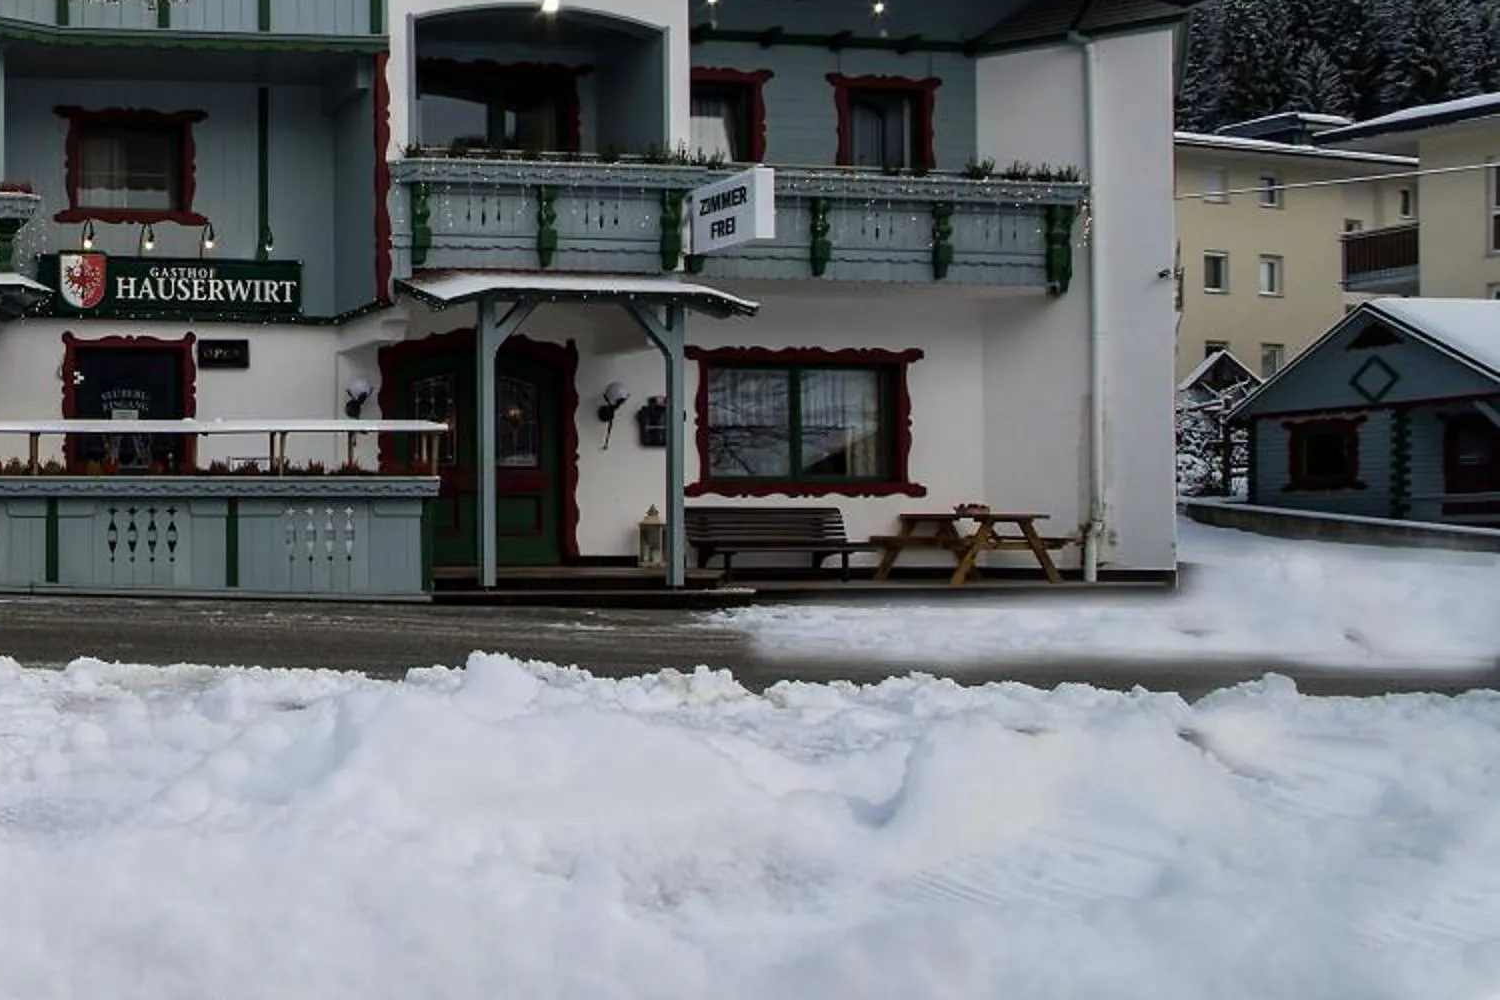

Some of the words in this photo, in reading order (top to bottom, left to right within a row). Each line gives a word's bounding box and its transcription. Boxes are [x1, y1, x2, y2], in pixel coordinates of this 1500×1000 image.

[699, 185, 747, 216] ZIMMER
[710, 216, 735, 239] FREI
[149, 266, 216, 279] GASTHOF
[116, 276, 297, 303] HAUSERWIRT
